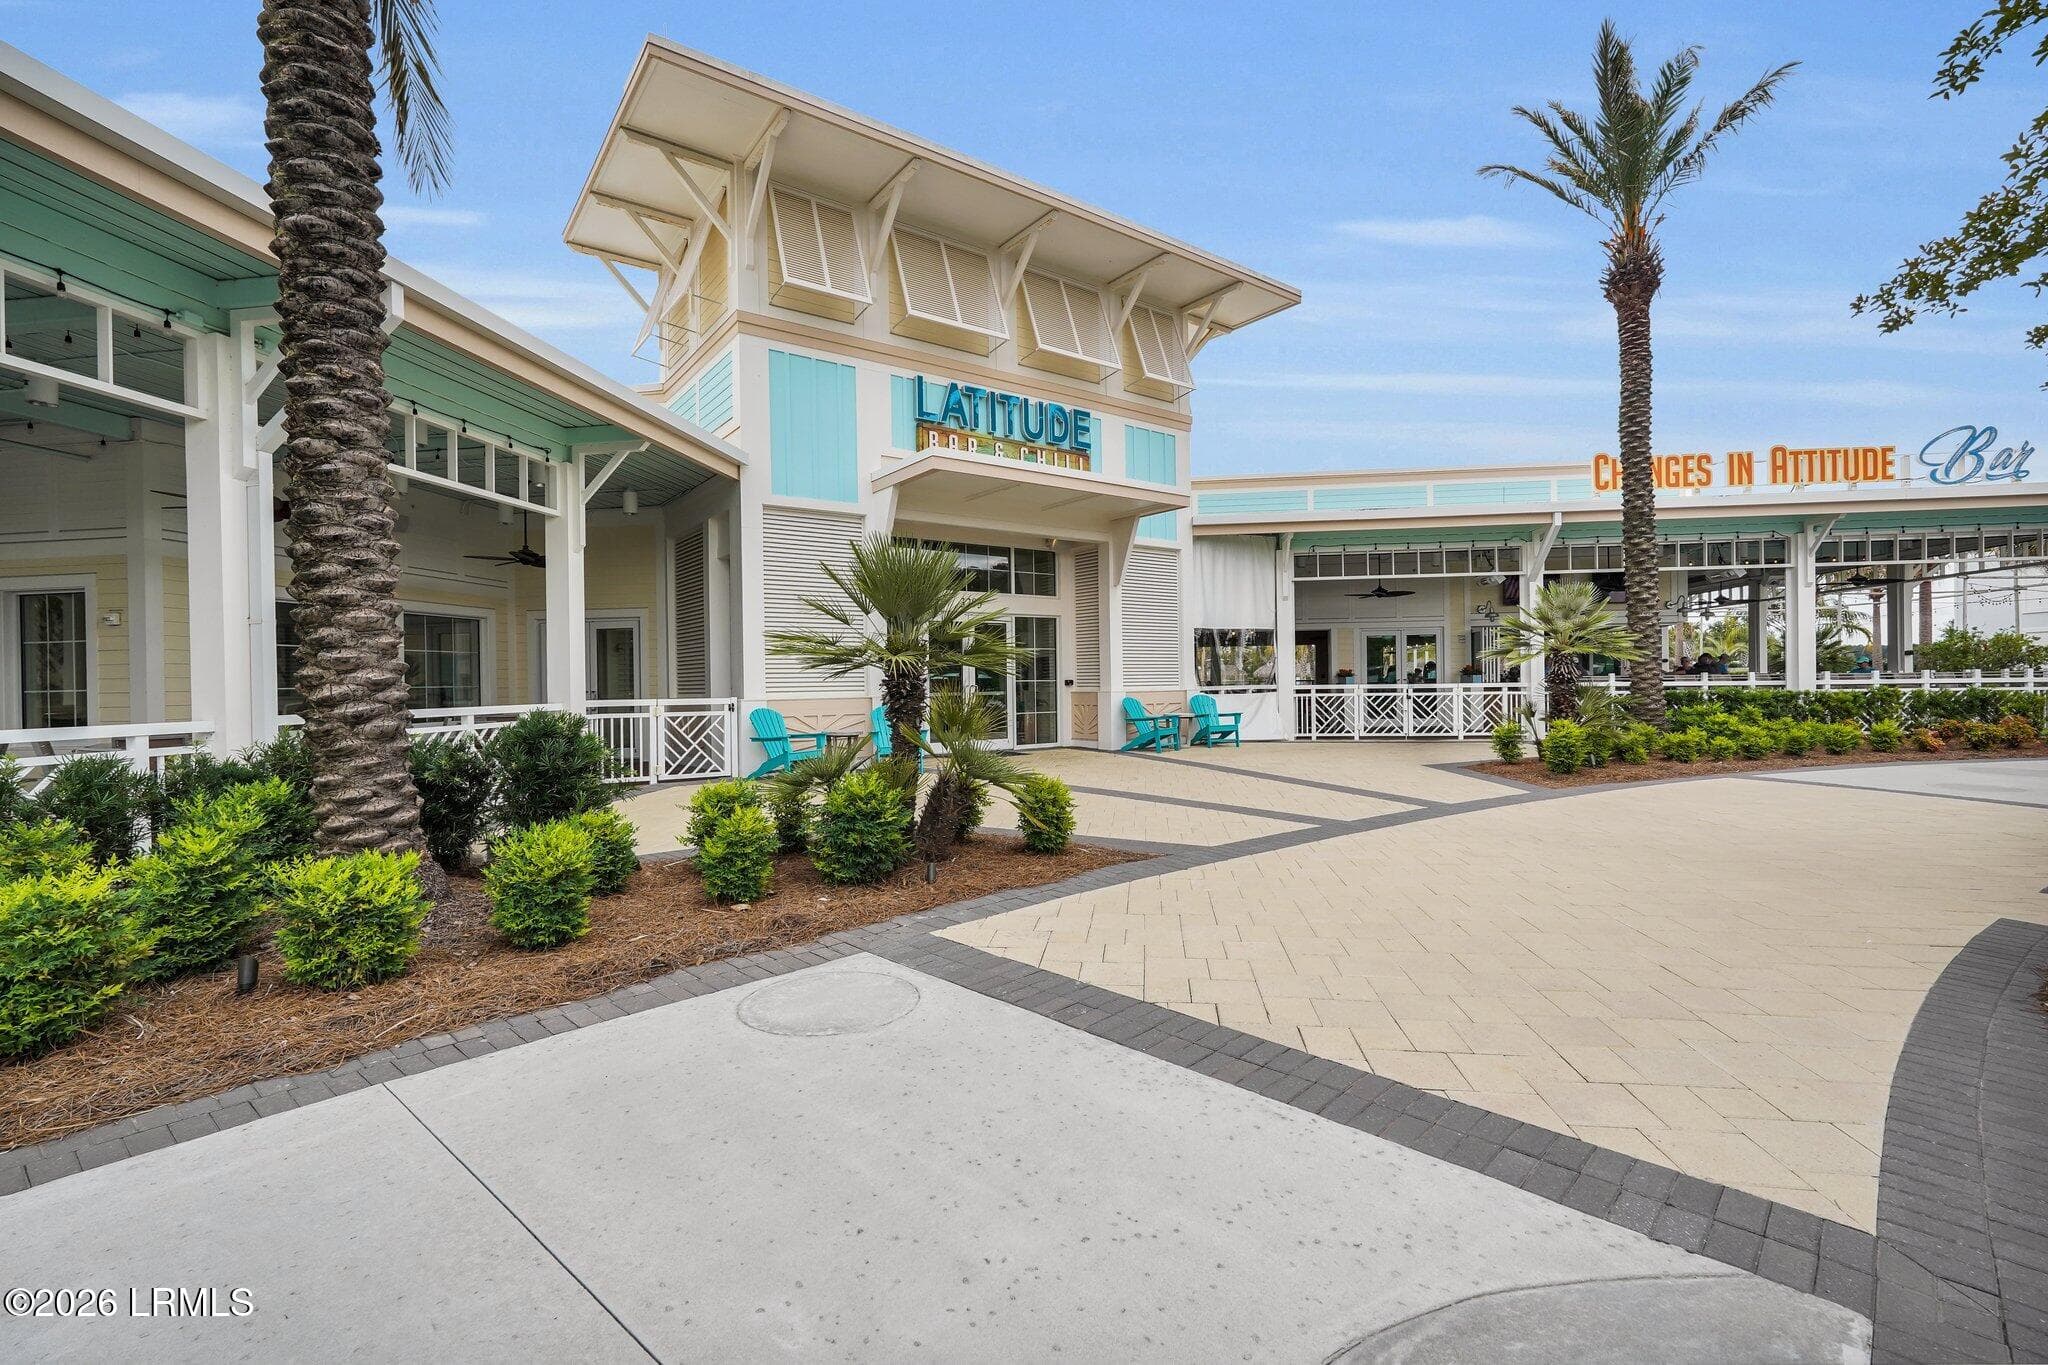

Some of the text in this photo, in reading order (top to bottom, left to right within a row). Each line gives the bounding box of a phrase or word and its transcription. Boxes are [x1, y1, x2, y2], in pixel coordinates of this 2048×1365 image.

[915, 375, 1092, 450] LATITUDE
[1592, 424, 2035, 491] CHNGES IN ATTITUDE Bar
